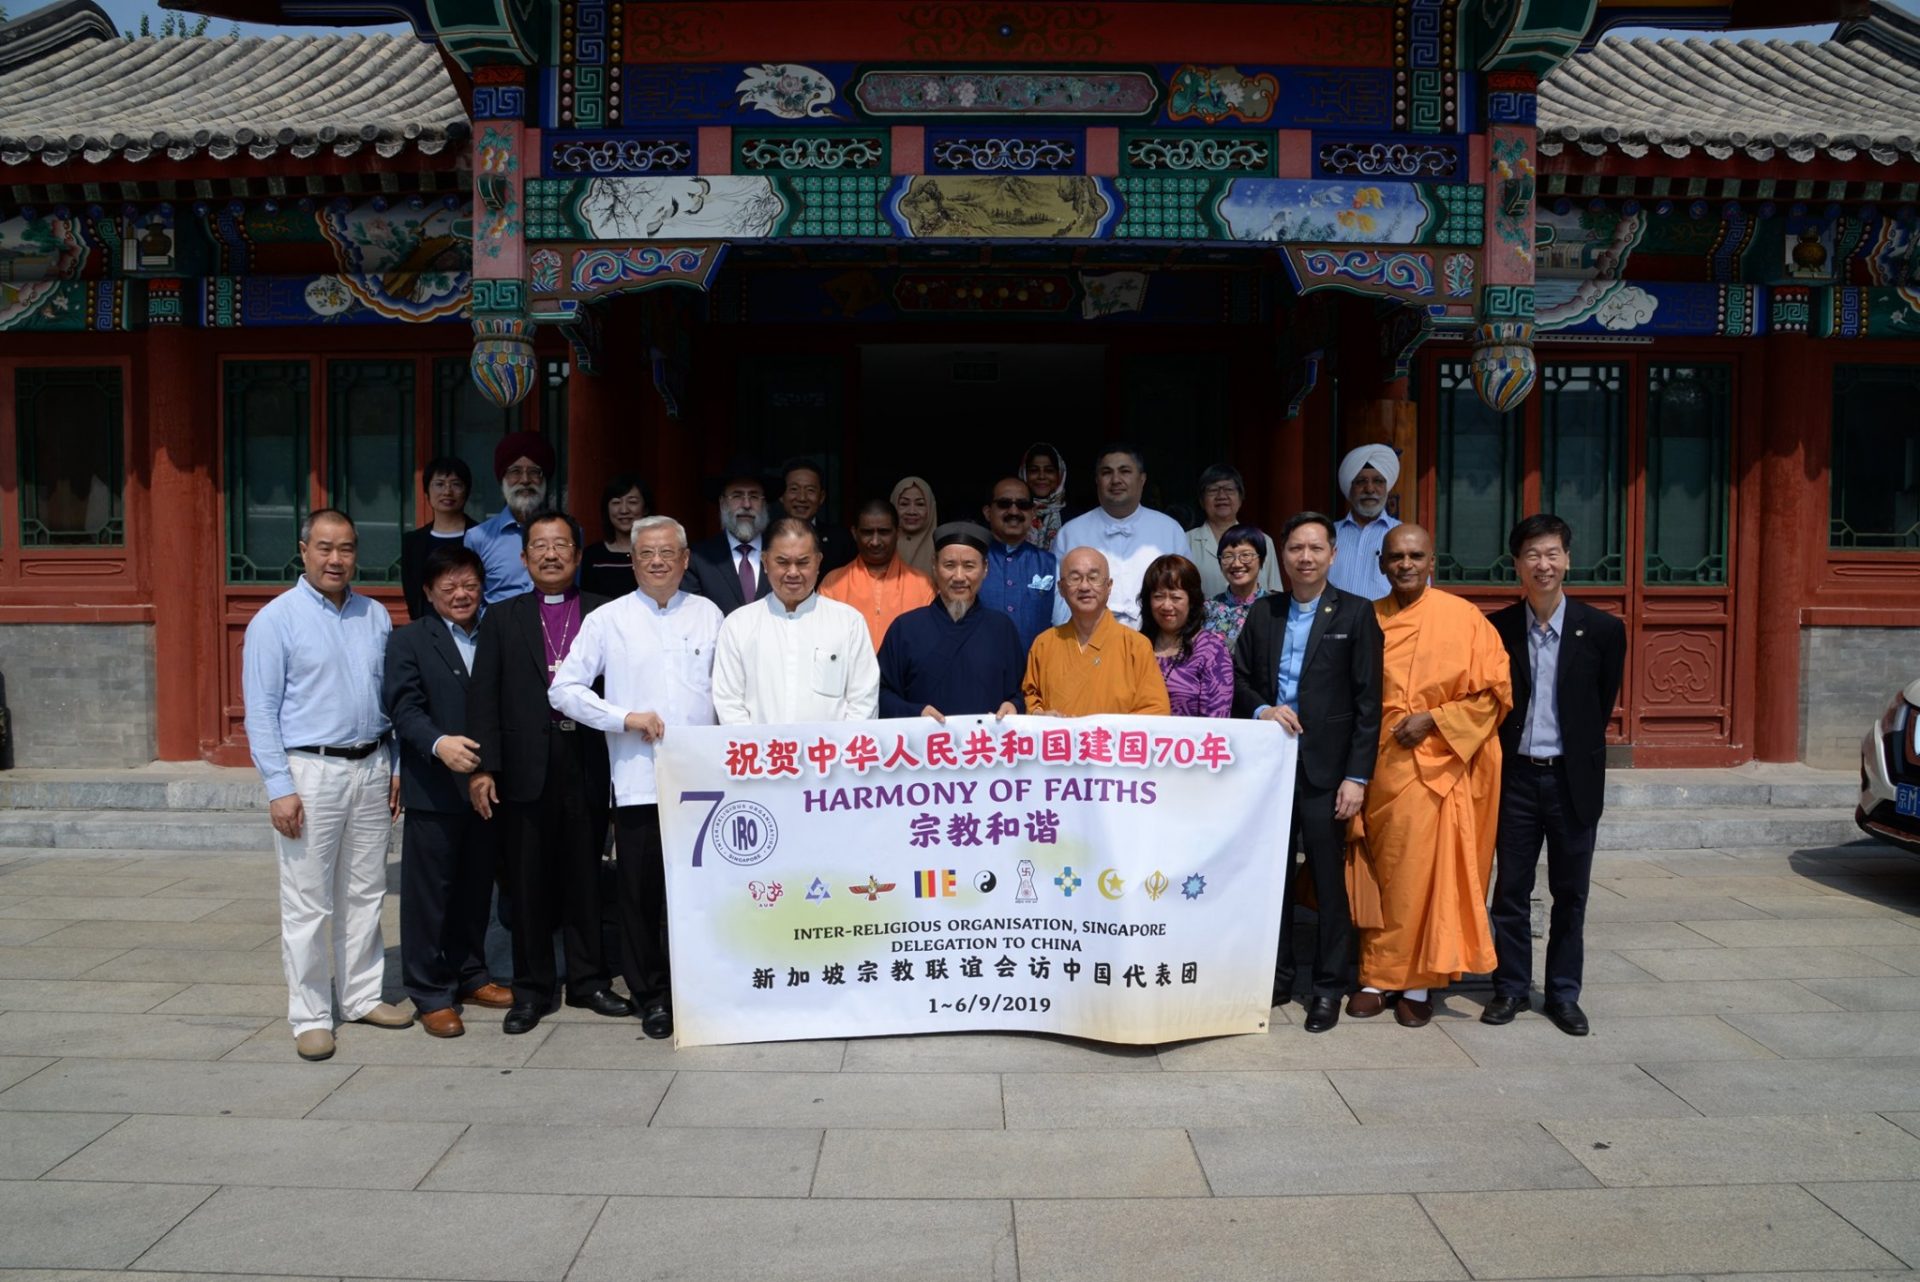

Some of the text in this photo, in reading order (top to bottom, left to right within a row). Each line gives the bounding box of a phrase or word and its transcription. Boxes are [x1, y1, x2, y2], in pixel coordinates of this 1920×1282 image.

[725, 726, 1231, 776] 祝贺中华人民共和国建国70年
[803, 778, 1157, 813] HARMONY OF FAITHS
[732, 816, 758, 850] IRO
[909, 809, 1060, 848] 宗教和谐
[794, 918, 1166, 940] INTER-RELIGIOUS ORGANISATION, SINGAPORE
[891, 937, 1082, 953] DELEGATION TO CHINA
[752, 954, 1198, 989] 新加坡宗教联谊会访中国代表团
[929, 994, 1051, 1013] 1~6/9/2019
